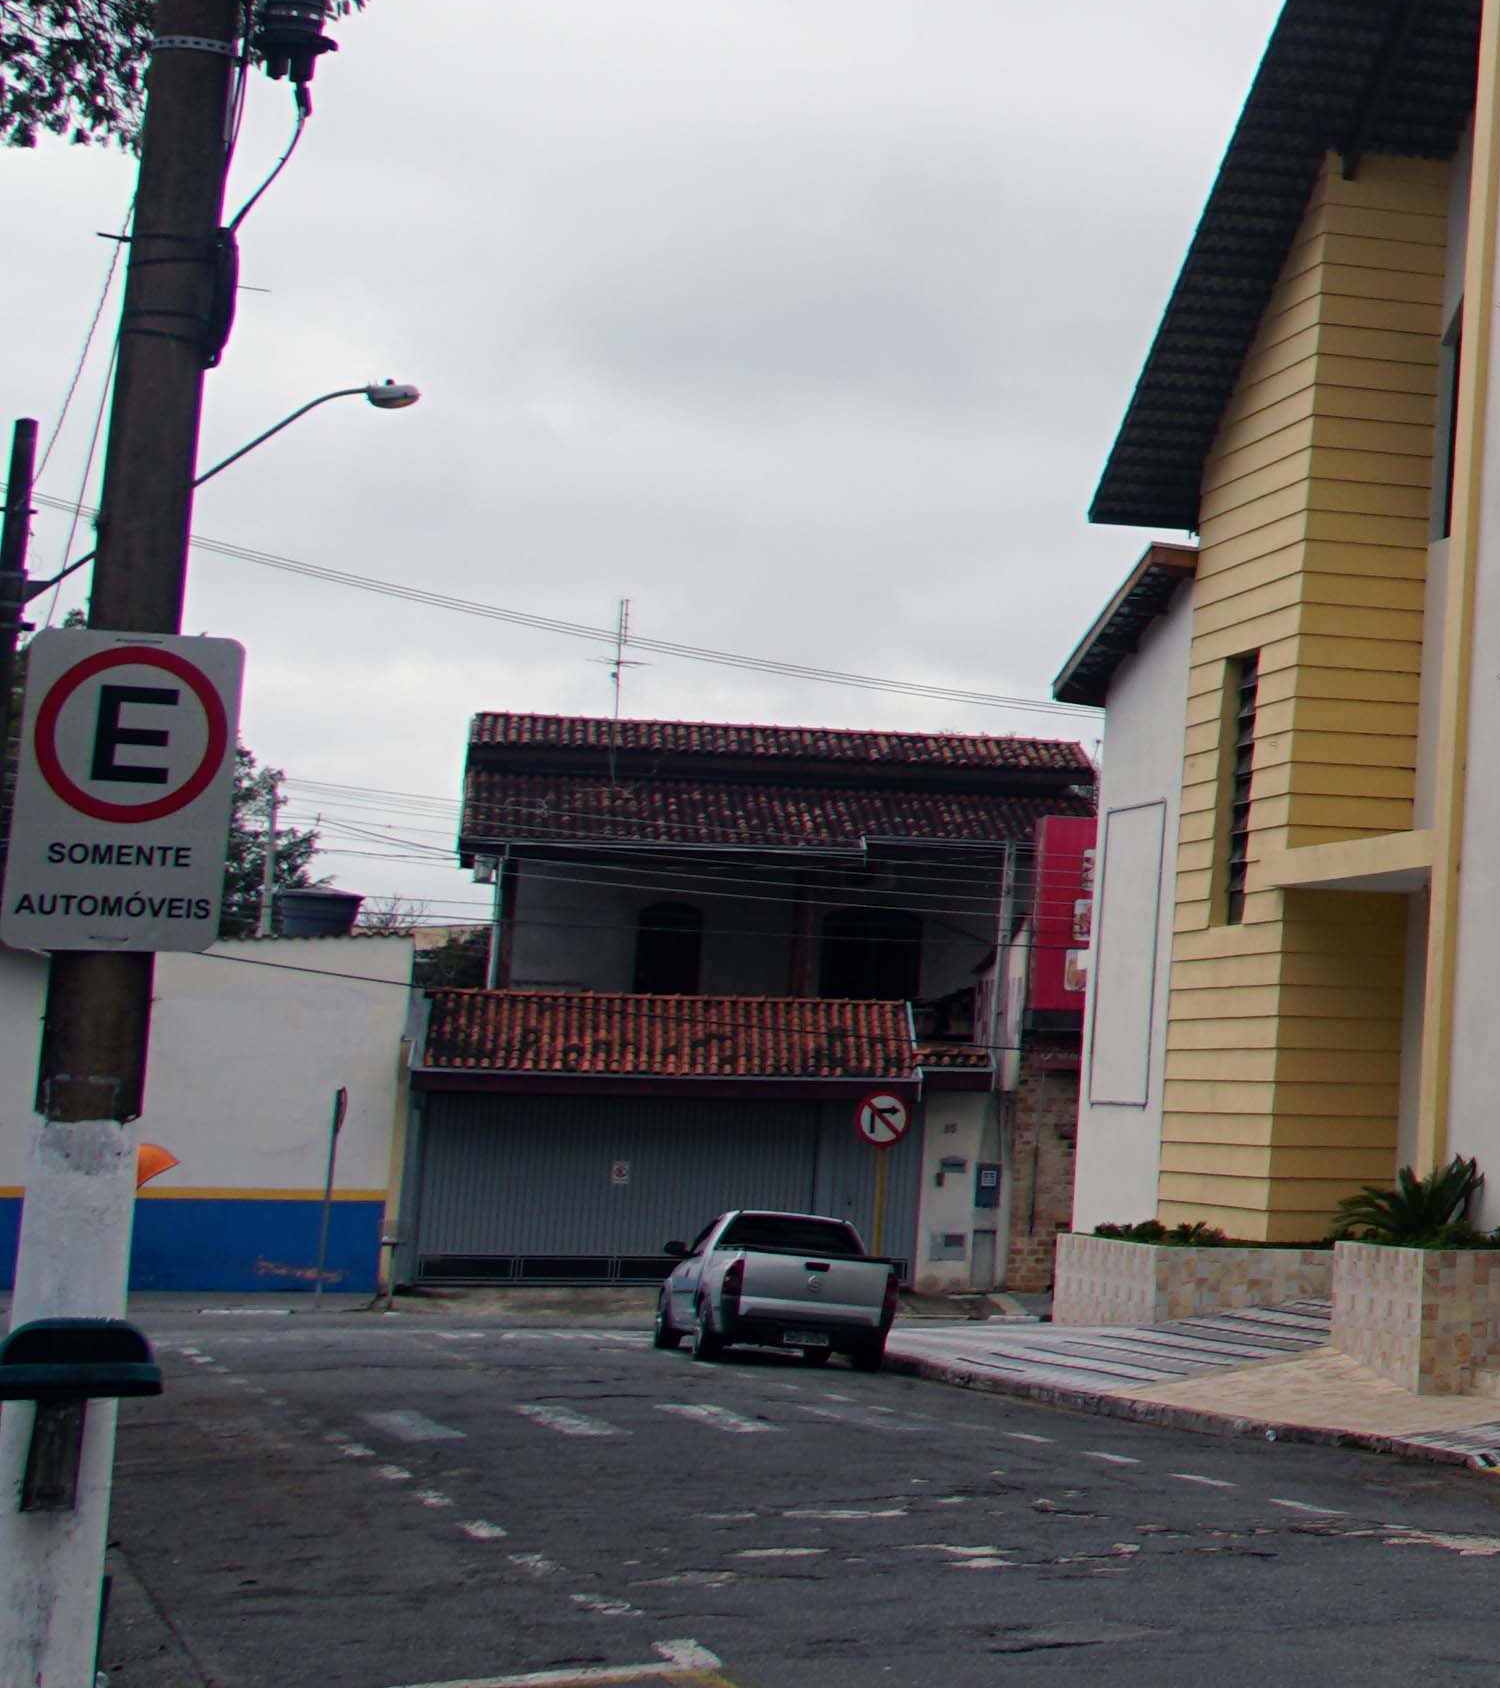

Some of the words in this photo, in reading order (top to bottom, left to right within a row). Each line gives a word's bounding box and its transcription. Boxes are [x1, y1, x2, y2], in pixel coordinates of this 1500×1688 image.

[90, 685, 180, 784] E
[48, 842, 192, 868] SOMENTE
[15, 891, 212, 920] AUTOMÓVEIS
